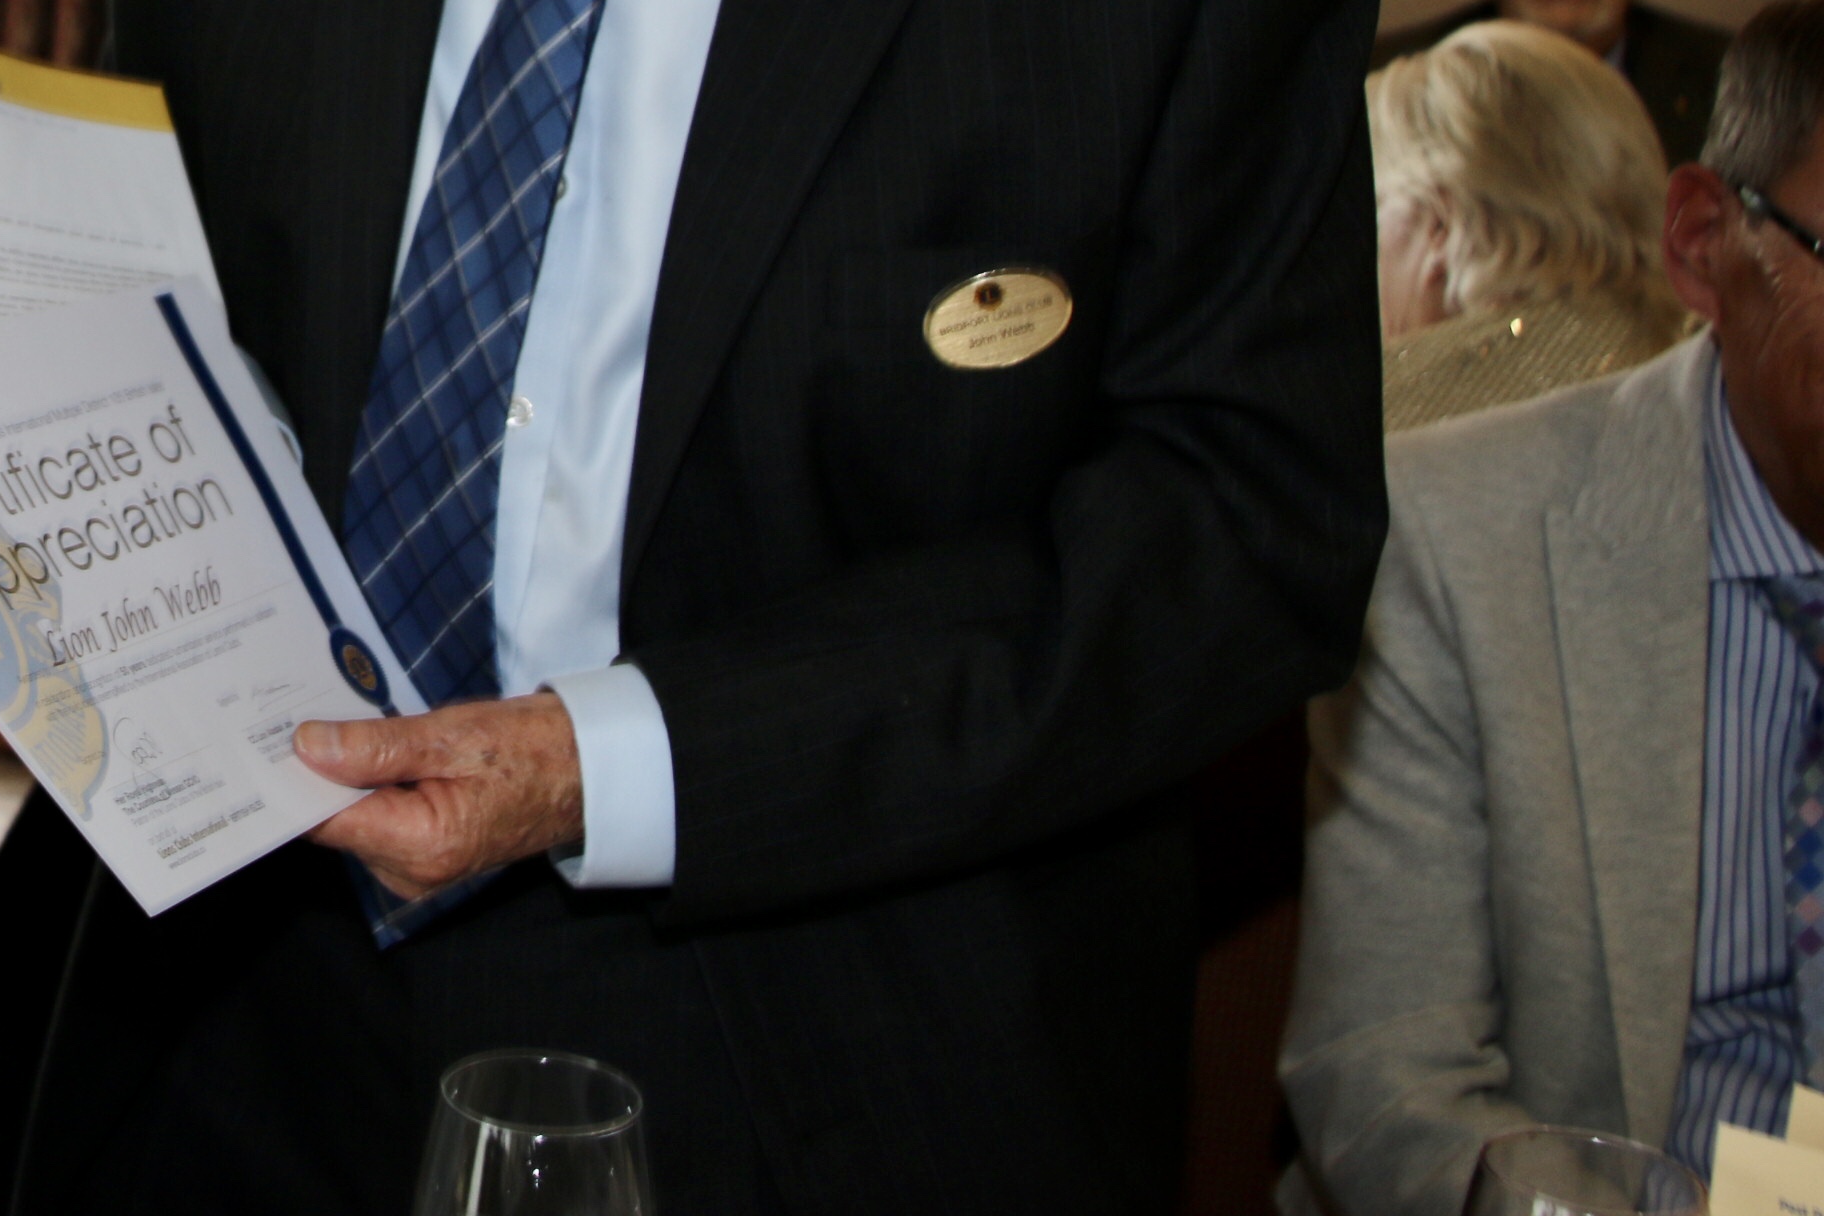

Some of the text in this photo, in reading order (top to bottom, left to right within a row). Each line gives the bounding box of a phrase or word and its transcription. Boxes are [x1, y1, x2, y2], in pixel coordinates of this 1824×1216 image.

[149, 405, 197, 465] of
[42, 617, 98, 667] Lion
[102, 596, 158, 652] John
[154, 565, 222, 625] Webb
